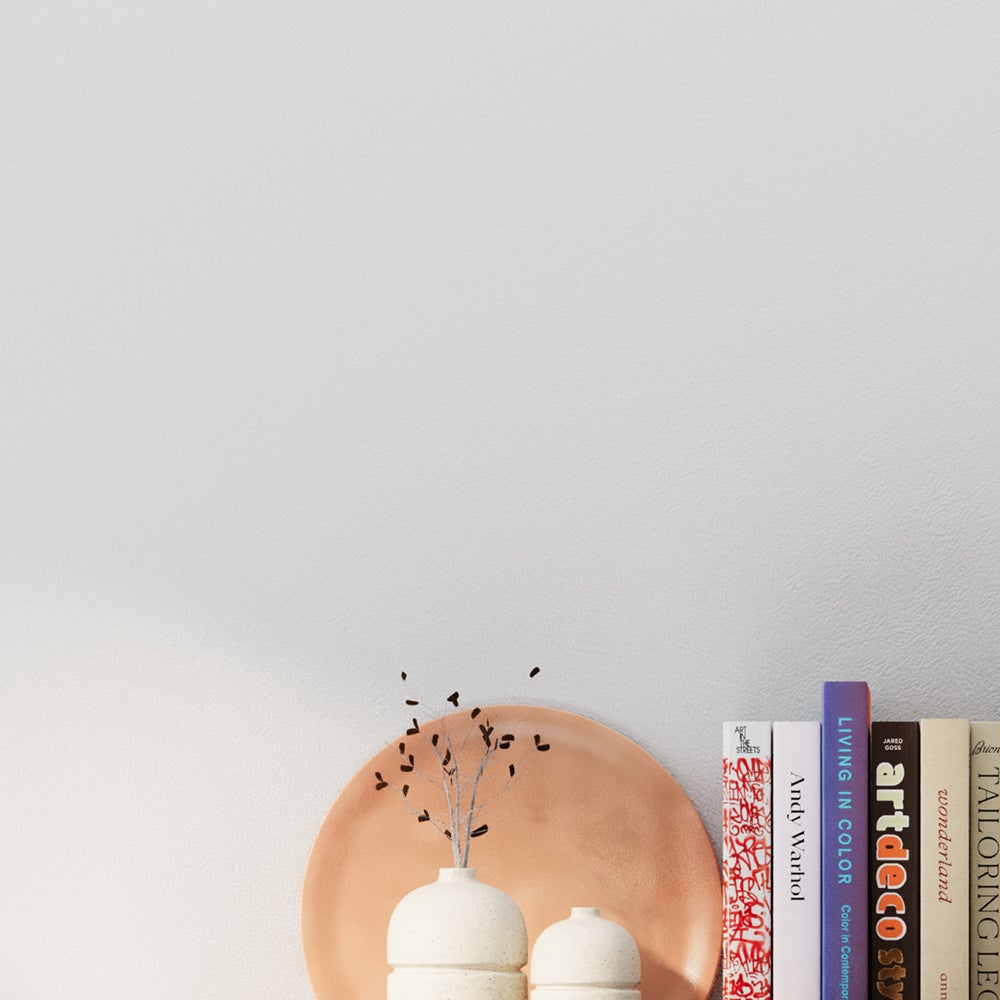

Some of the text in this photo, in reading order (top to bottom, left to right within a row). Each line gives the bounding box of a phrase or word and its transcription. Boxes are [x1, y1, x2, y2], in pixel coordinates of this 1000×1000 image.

[736, 745, 761, 754] STREETS
[838, 718, 852, 883] LIVING IN COLOR
[787, 772, 806, 900] Andy Warhol
[938, 789, 952, 903] wonderland
[977, 767, 999, 939] TAILORING
[840, 904, 851, 936] Color
